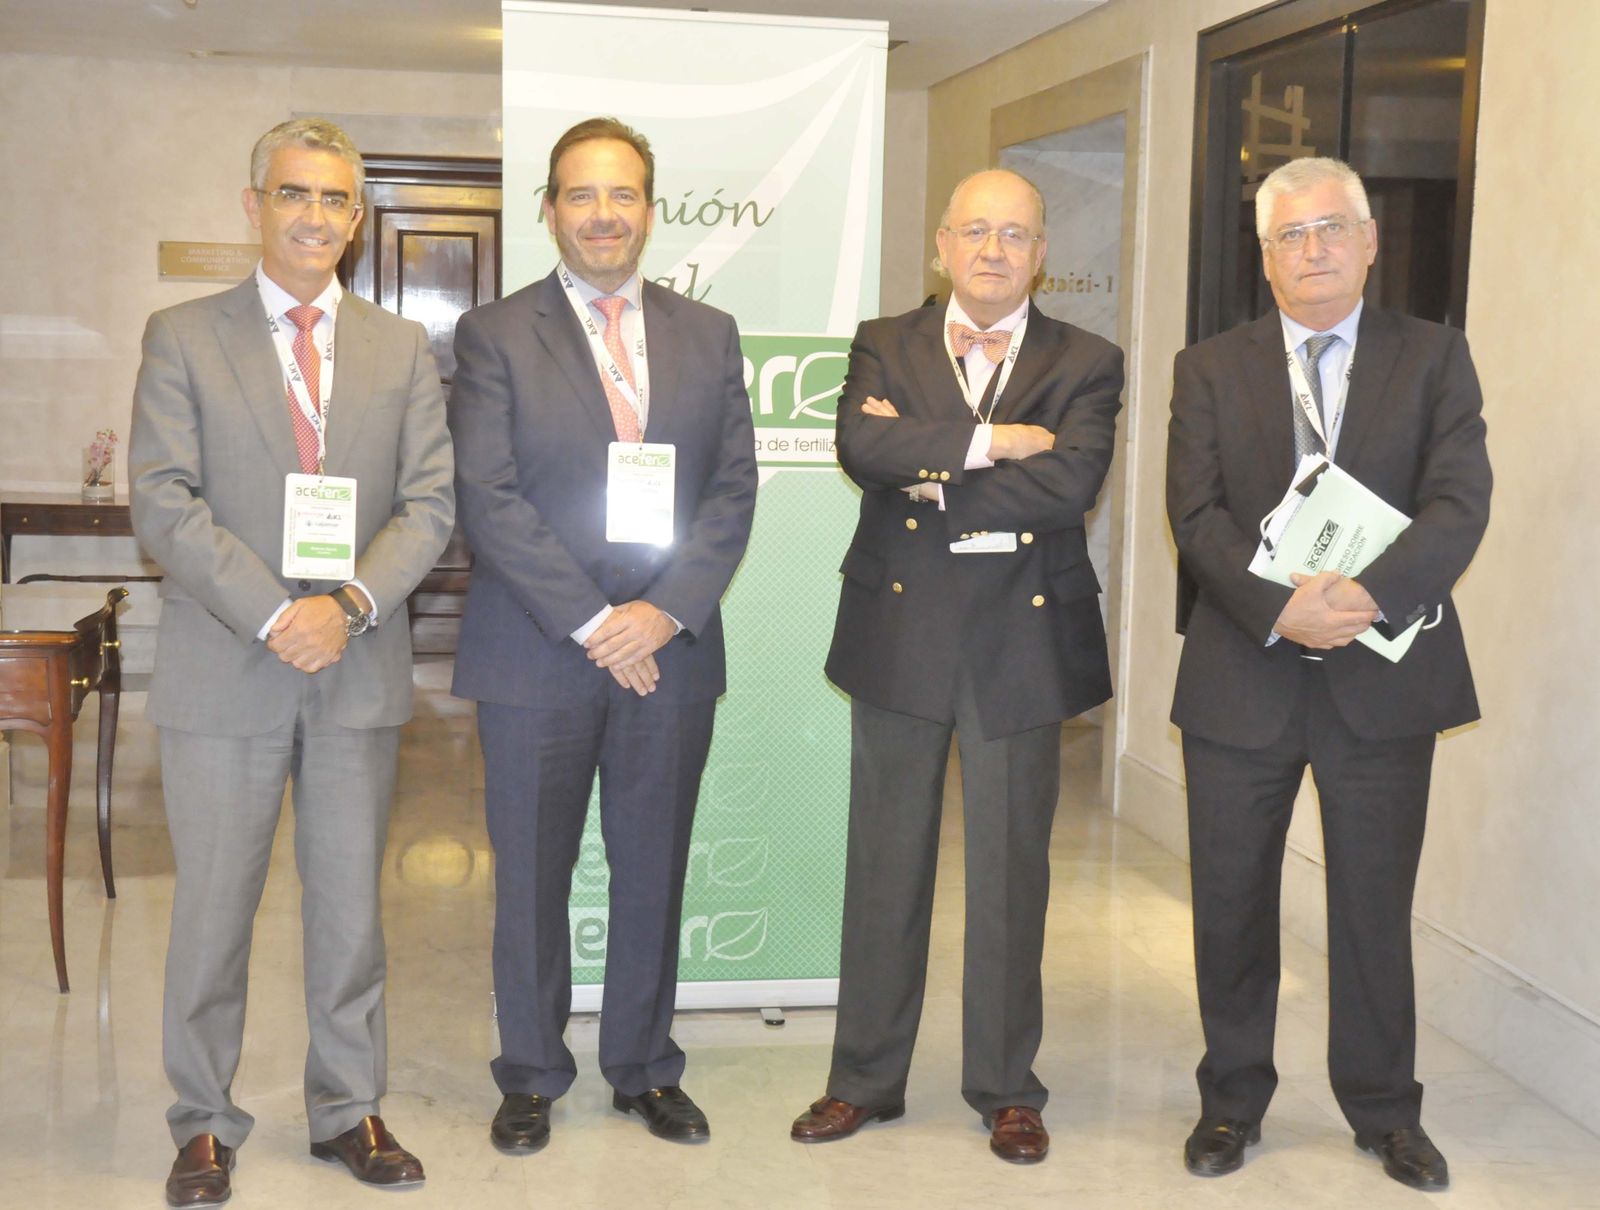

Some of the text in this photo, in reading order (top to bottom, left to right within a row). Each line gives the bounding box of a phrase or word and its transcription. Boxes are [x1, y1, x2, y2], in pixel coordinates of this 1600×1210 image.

[534, 185, 775, 228] nión
[180, 256, 250, 264] COMMUNICATION
[767, 438, 789, 452] de
[795, 438, 836, 452] fertiliz
